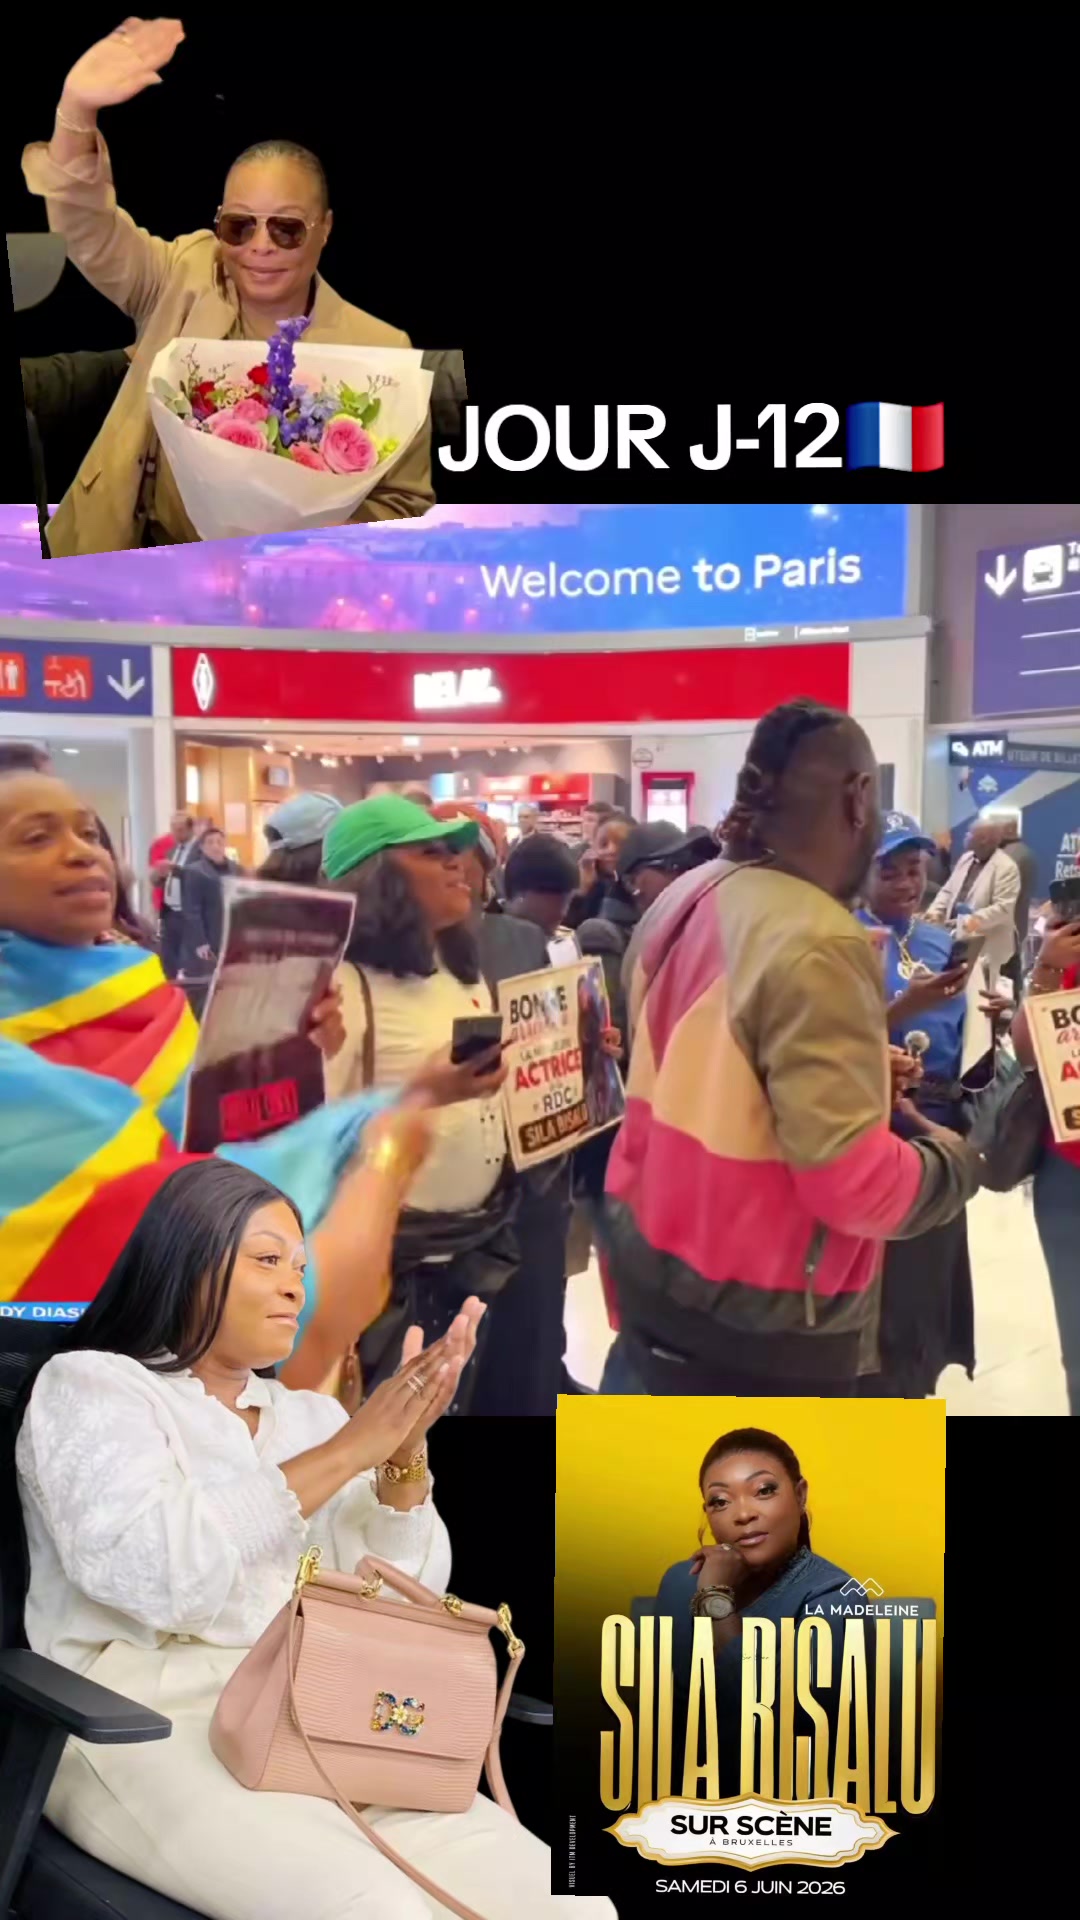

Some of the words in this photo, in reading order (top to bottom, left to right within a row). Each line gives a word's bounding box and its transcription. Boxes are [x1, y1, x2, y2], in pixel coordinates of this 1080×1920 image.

[480, 562, 681, 598] Welcome
[692, 557, 740, 592] to
[753, 547, 861, 589] Paris
[972, 740, 1005, 757] ATM
[515, 1048, 582, 1091] ACTRICE
[543, 1087, 573, 1113] RDC
[805, 1603, 825, 1616] LA
[830, 1603, 919, 1617] MADELEINE
[670, 1814, 729, 1835] SUR
[736, 1810, 832, 1837] SCÈNE
[722, 1839, 793, 1847] BRUXELLES
[655, 1879, 730, 1894] SAMEDI
[734, 1879, 748, 1894] 6
[751, 1879, 793, 1894] JUIN
[796, 1880, 846, 1895] 2026
